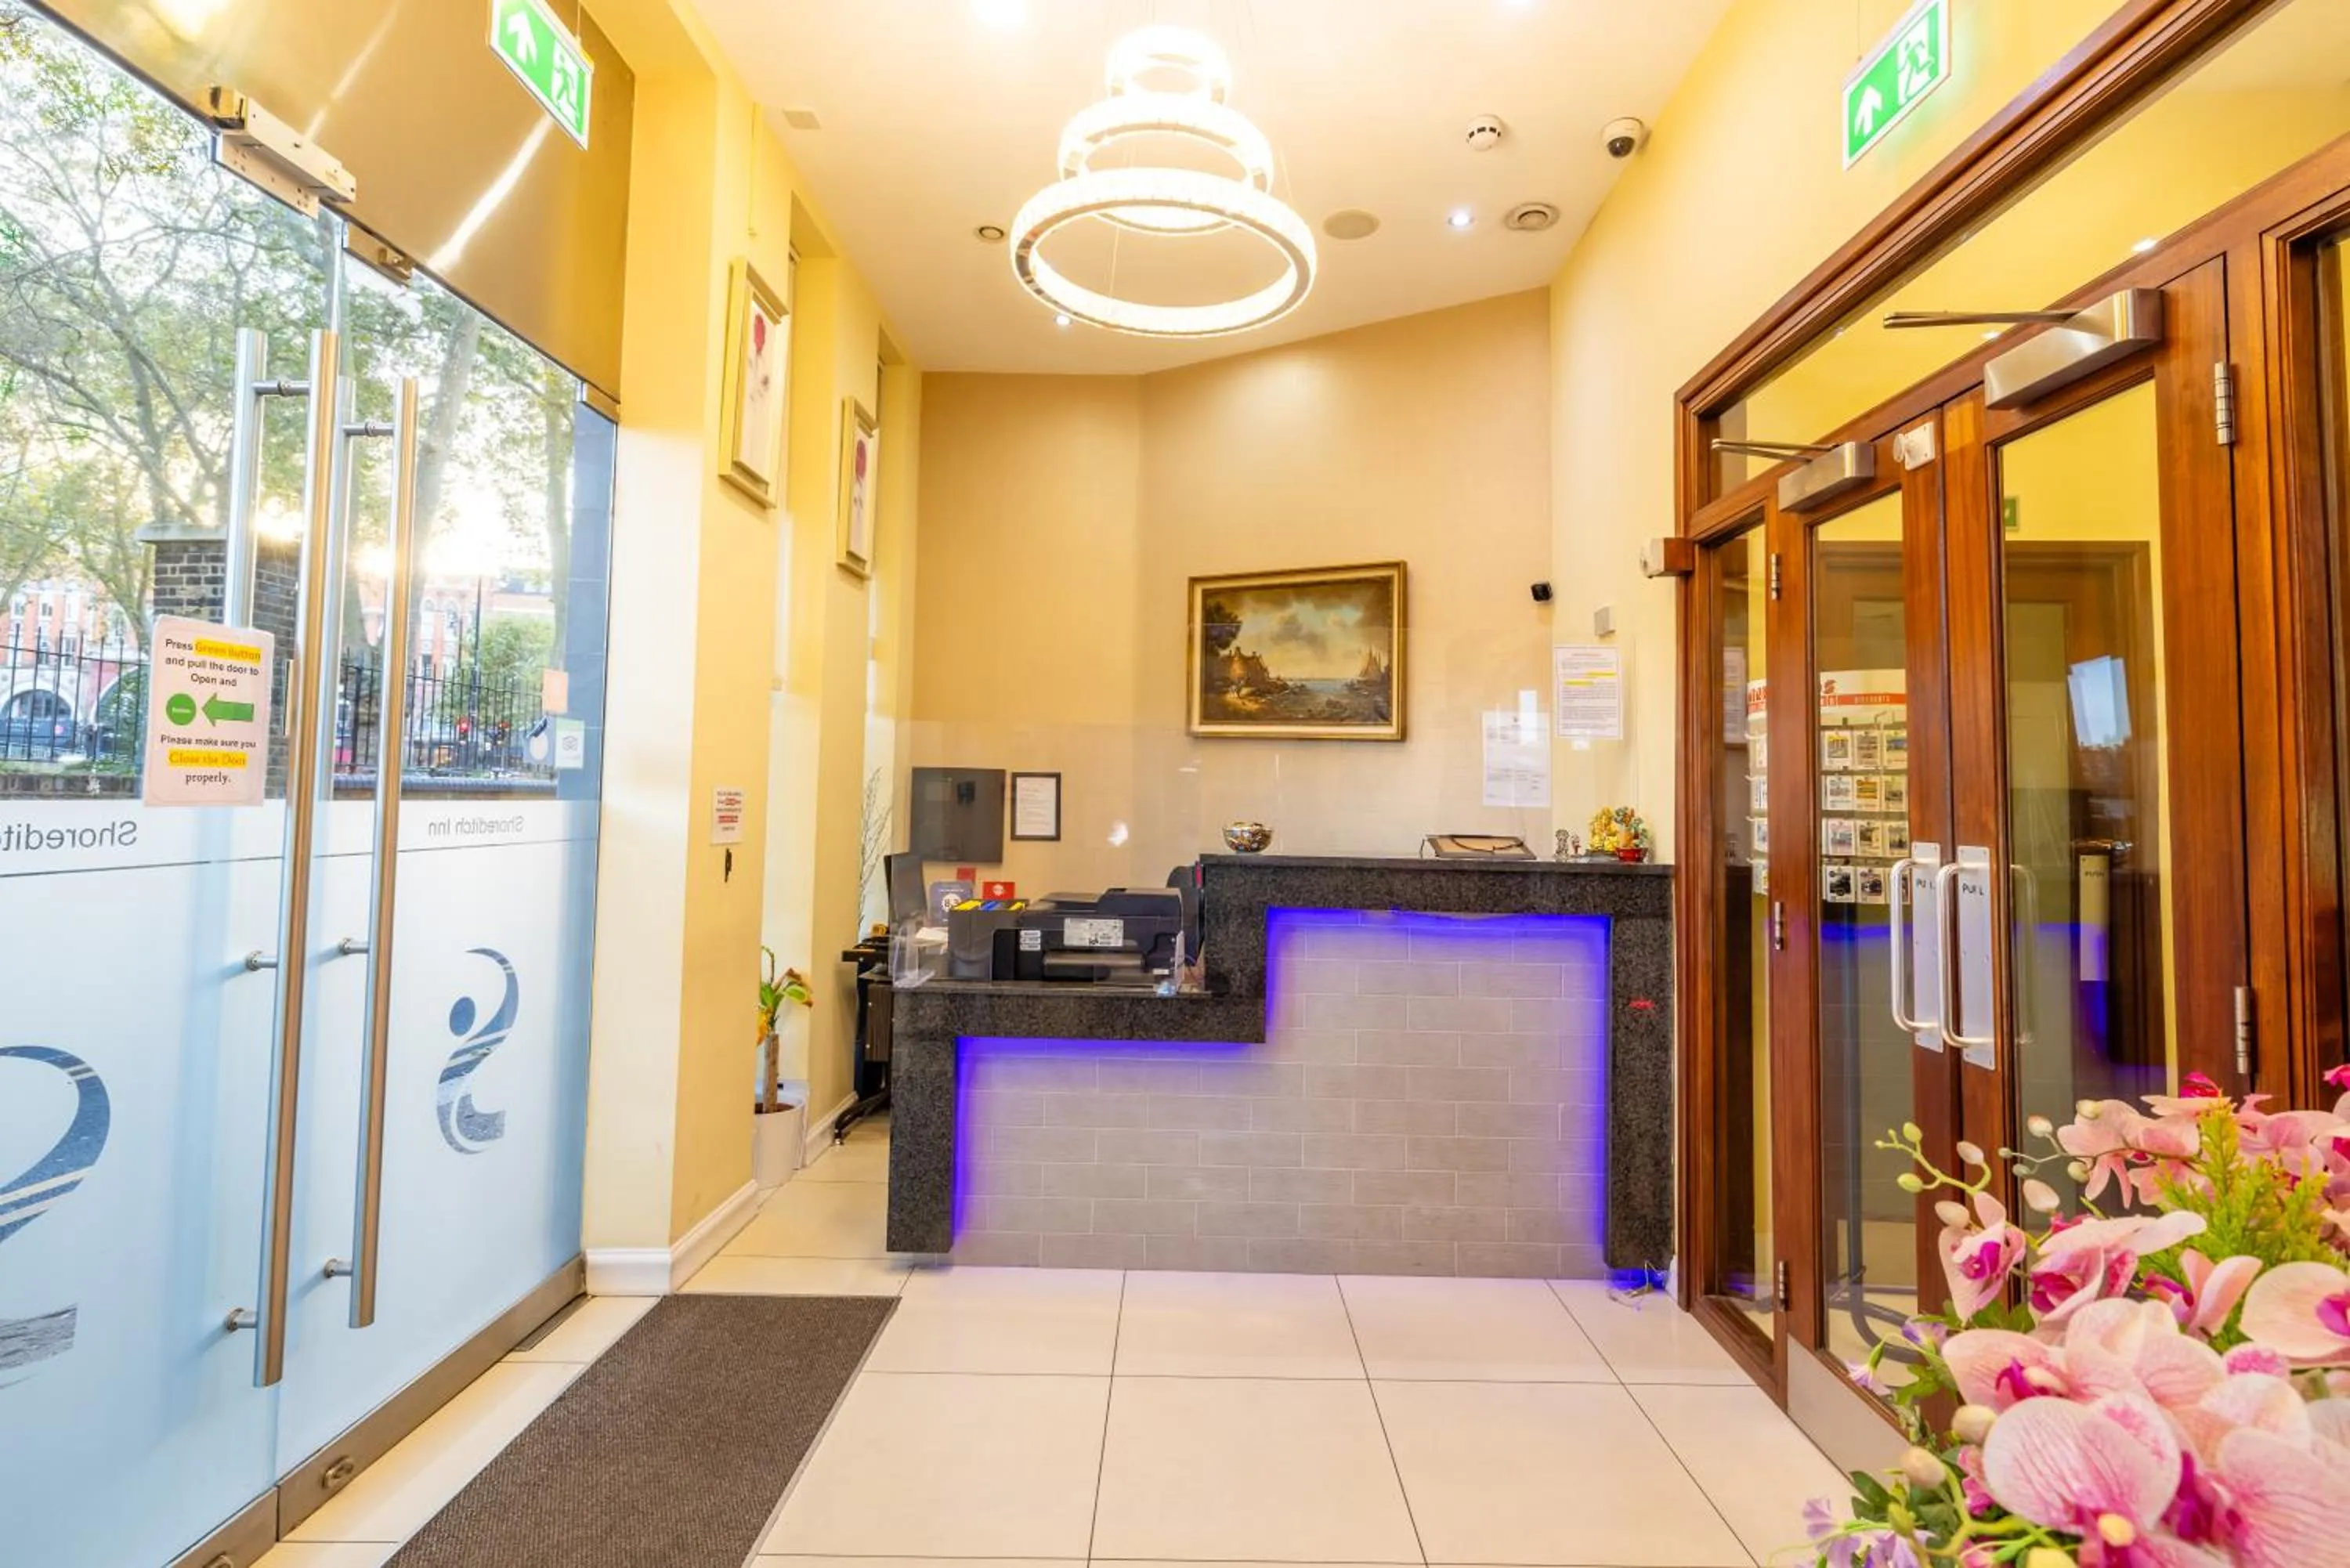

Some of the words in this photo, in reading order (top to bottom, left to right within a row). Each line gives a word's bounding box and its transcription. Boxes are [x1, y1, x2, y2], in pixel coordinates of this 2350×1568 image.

[165, 638, 193, 651] Press
[195, 641, 226, 656] Green
[165, 657, 185, 667] and
[187, 659, 207, 669] pull
[209, 661, 224, 671] the
[226, 663, 248, 674] door
[250, 667, 259, 676] to
[190, 673, 217, 685] Open
[219, 678, 237, 687] and
[161, 734, 193, 745] Please
[195, 738, 219, 746] make
[220, 739, 239, 747] sure
[240, 741, 257, 750] you
[168, 750, 201, 764] Close
[203, 752, 219, 764] the
[185, 771, 231, 786] properly.
[1915, 877, 1936, 891] PUL
